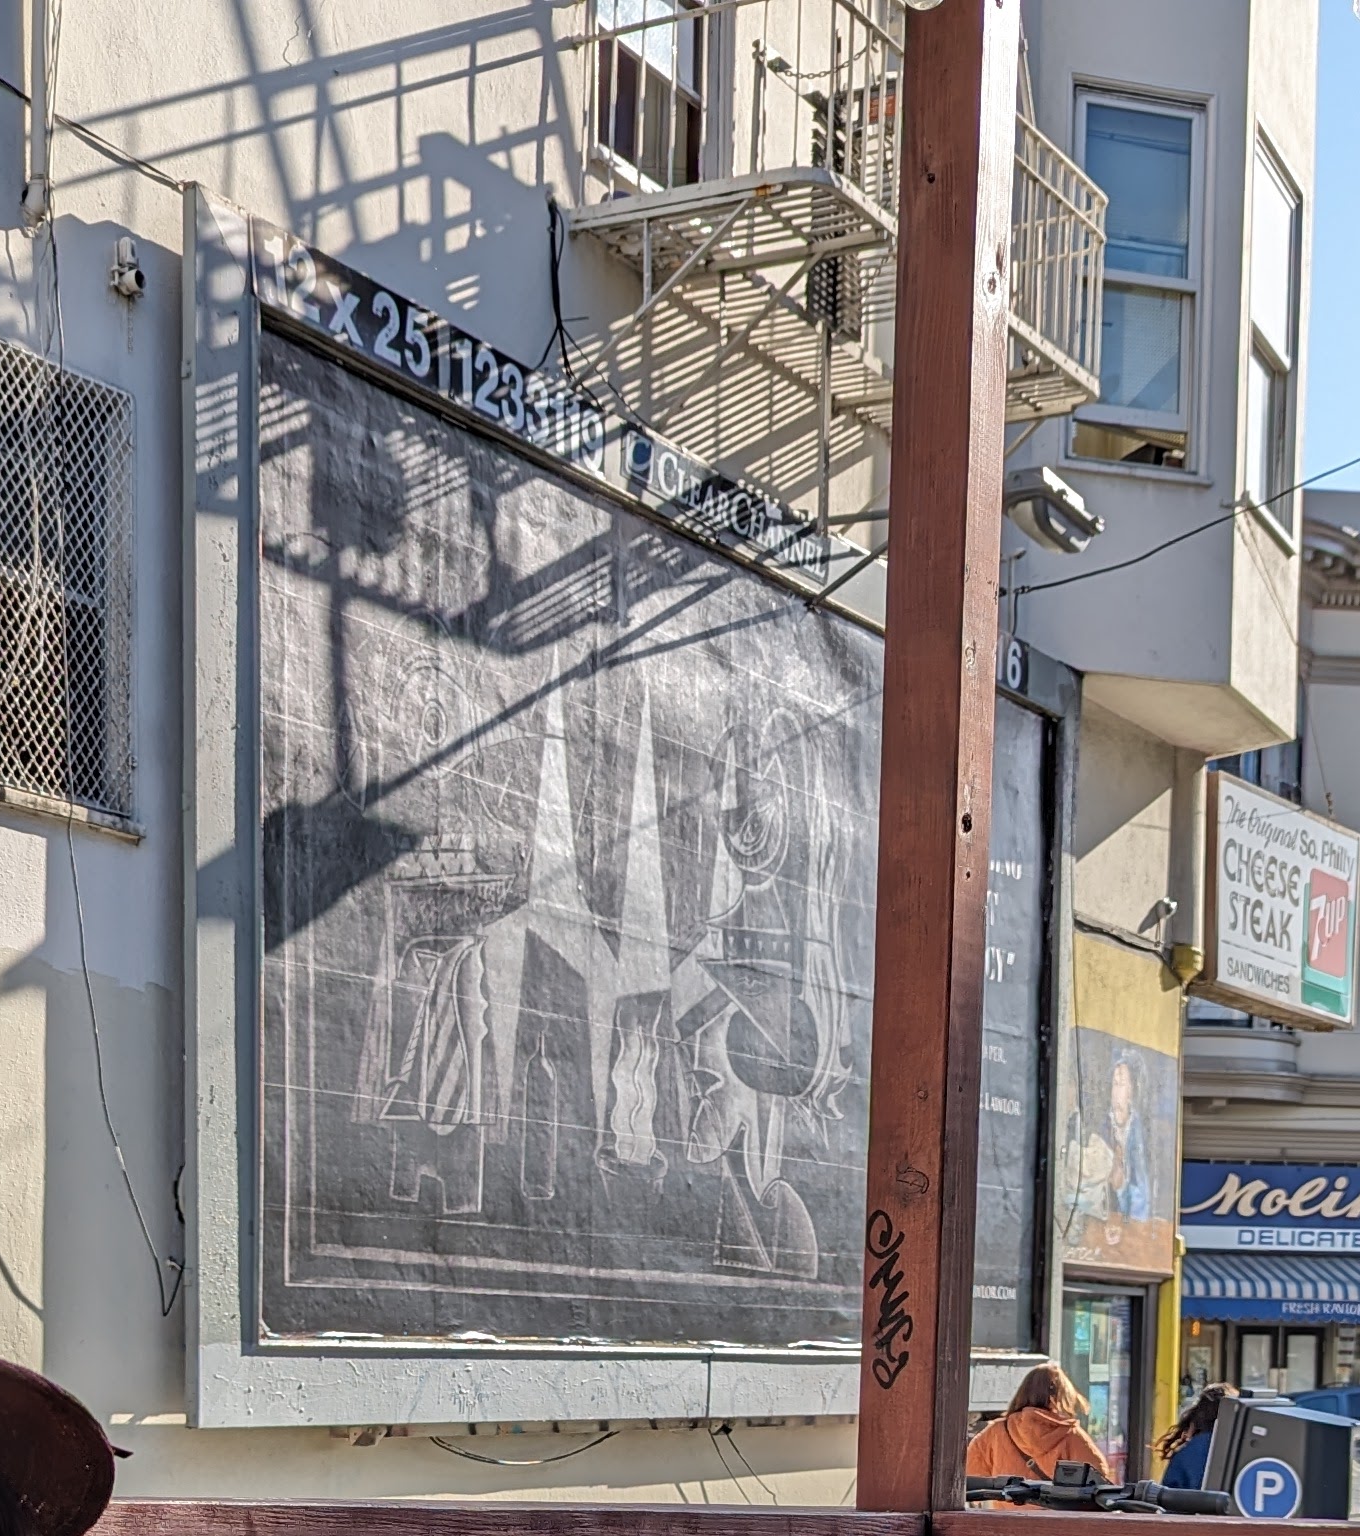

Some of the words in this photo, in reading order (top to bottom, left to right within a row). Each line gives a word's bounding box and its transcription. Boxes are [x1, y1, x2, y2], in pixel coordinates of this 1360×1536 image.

[372, 290, 431, 378] 25
[1225, 795, 1246, 829] The
[1246, 807, 1299, 851] Original
[1299, 829, 1317, 860] So.
[1322, 840, 1356, 880] Philly
[1223, 838, 1301, 907] CHEESE
[1229, 891, 1293, 952] STEAK
[1227, 957, 1290, 994] SANDWICHES
[1281, 1302, 1320, 1315] FRESH
[1254, 1470, 1285, 1512] P
